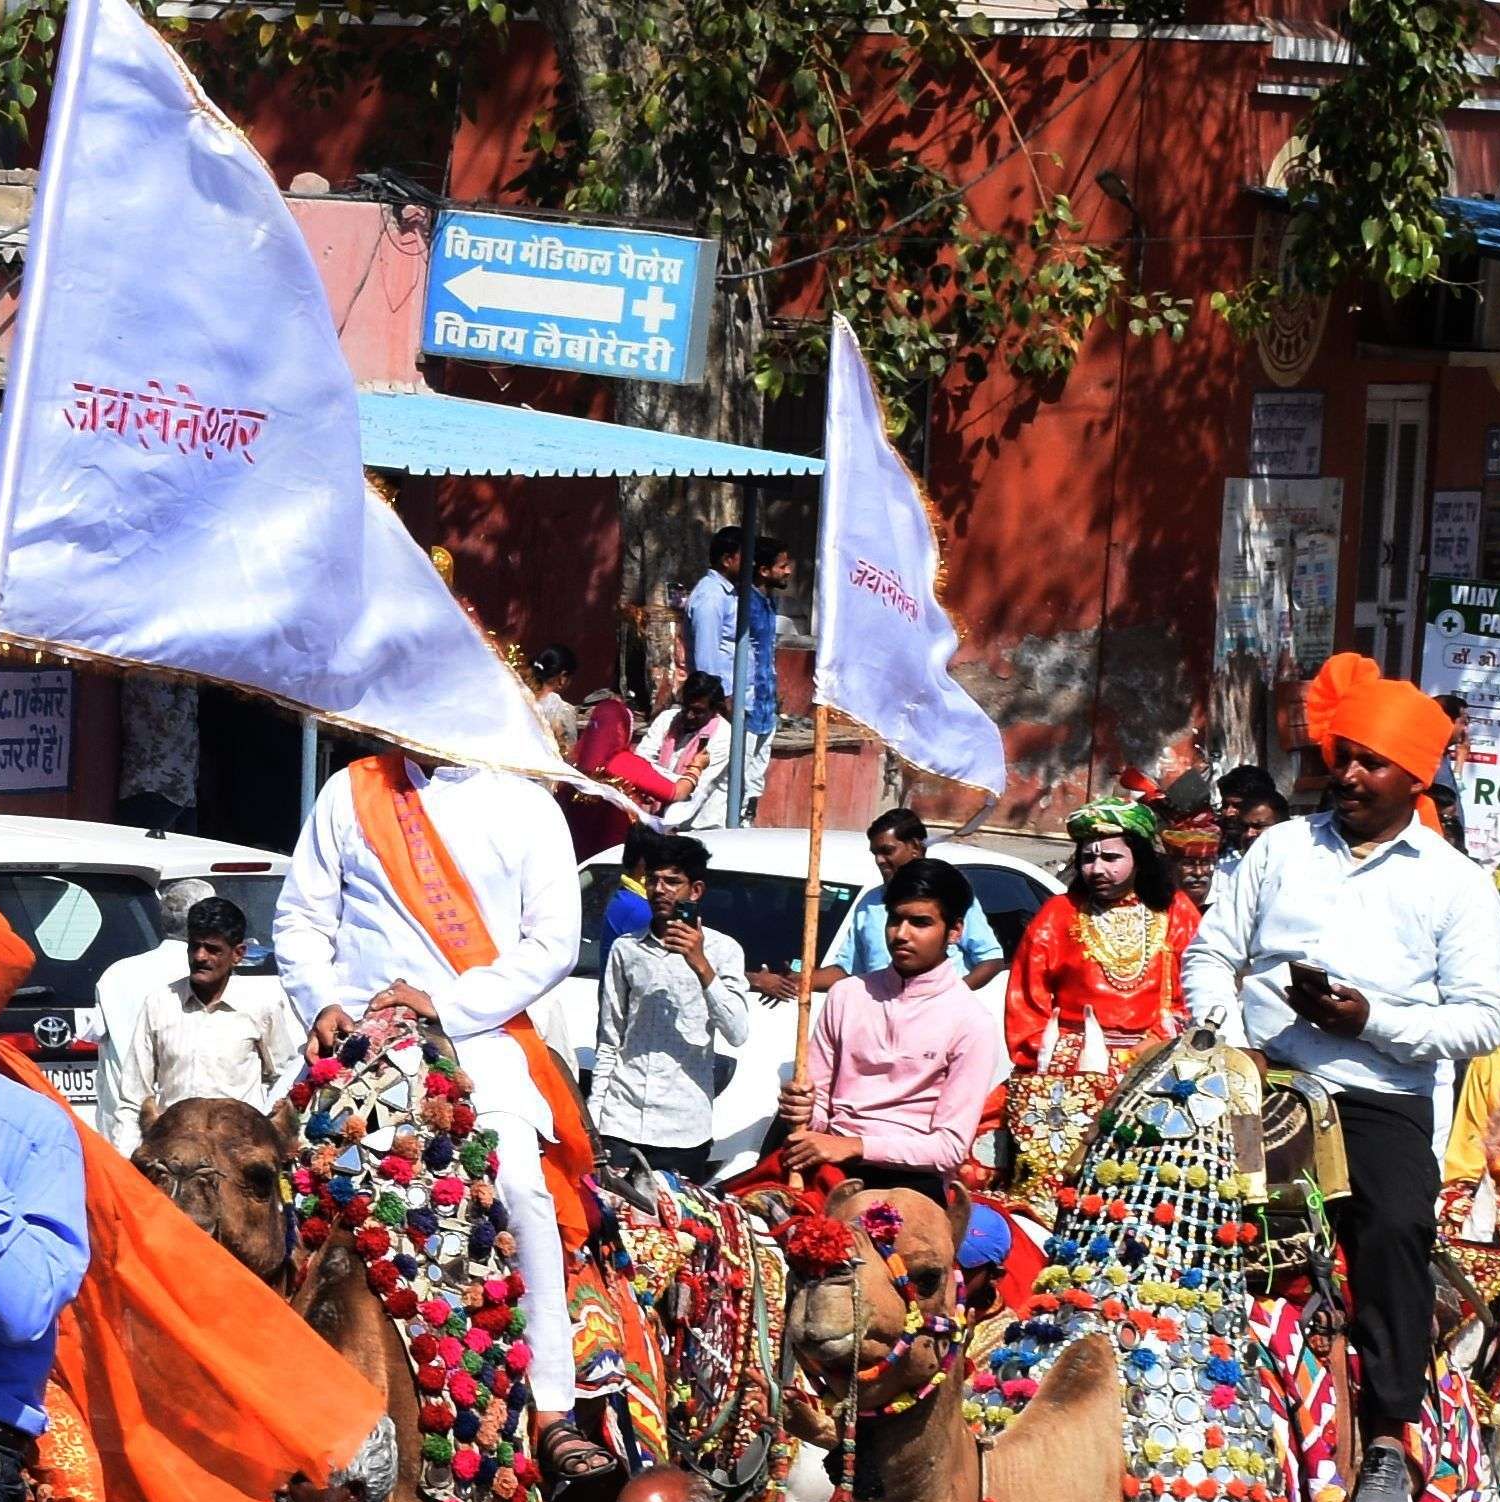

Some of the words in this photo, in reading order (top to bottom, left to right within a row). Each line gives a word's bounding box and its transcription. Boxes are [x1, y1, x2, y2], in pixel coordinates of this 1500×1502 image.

[444, 225, 517, 265] विजय
[520, 234, 614, 277] मेडिकल
[617, 243, 684, 285] पैलेस
[433, 311, 528, 355] विजय
[532, 321, 676, 373] लैबोरेटरी
[1450, 585, 1498, 608] VIJAY
[45, 1069, 94, 1091] C005
